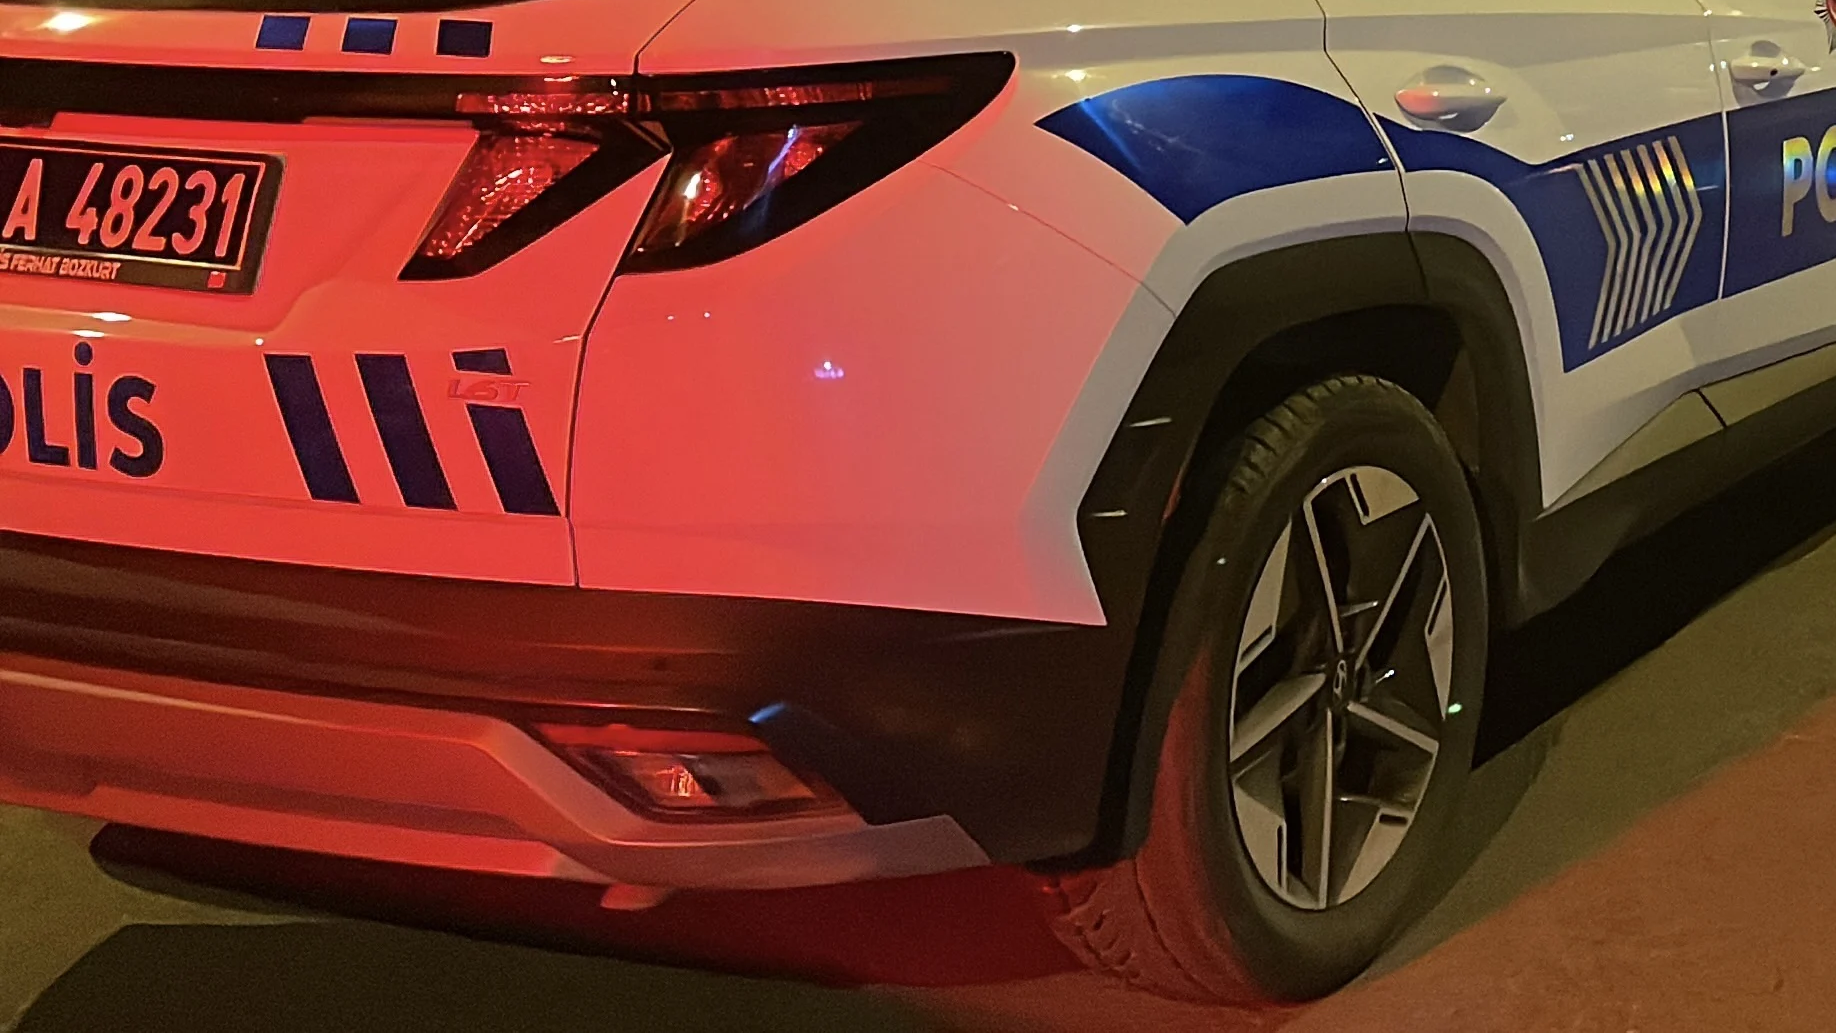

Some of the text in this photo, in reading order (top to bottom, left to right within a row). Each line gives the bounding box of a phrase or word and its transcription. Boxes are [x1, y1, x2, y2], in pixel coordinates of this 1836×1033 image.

[2, 158, 246, 257] A 48231
[10, 253, 60, 274] FERHAT
[59, 257, 121, 280] BOZKURT
[0, 341, 164, 478] LİS
